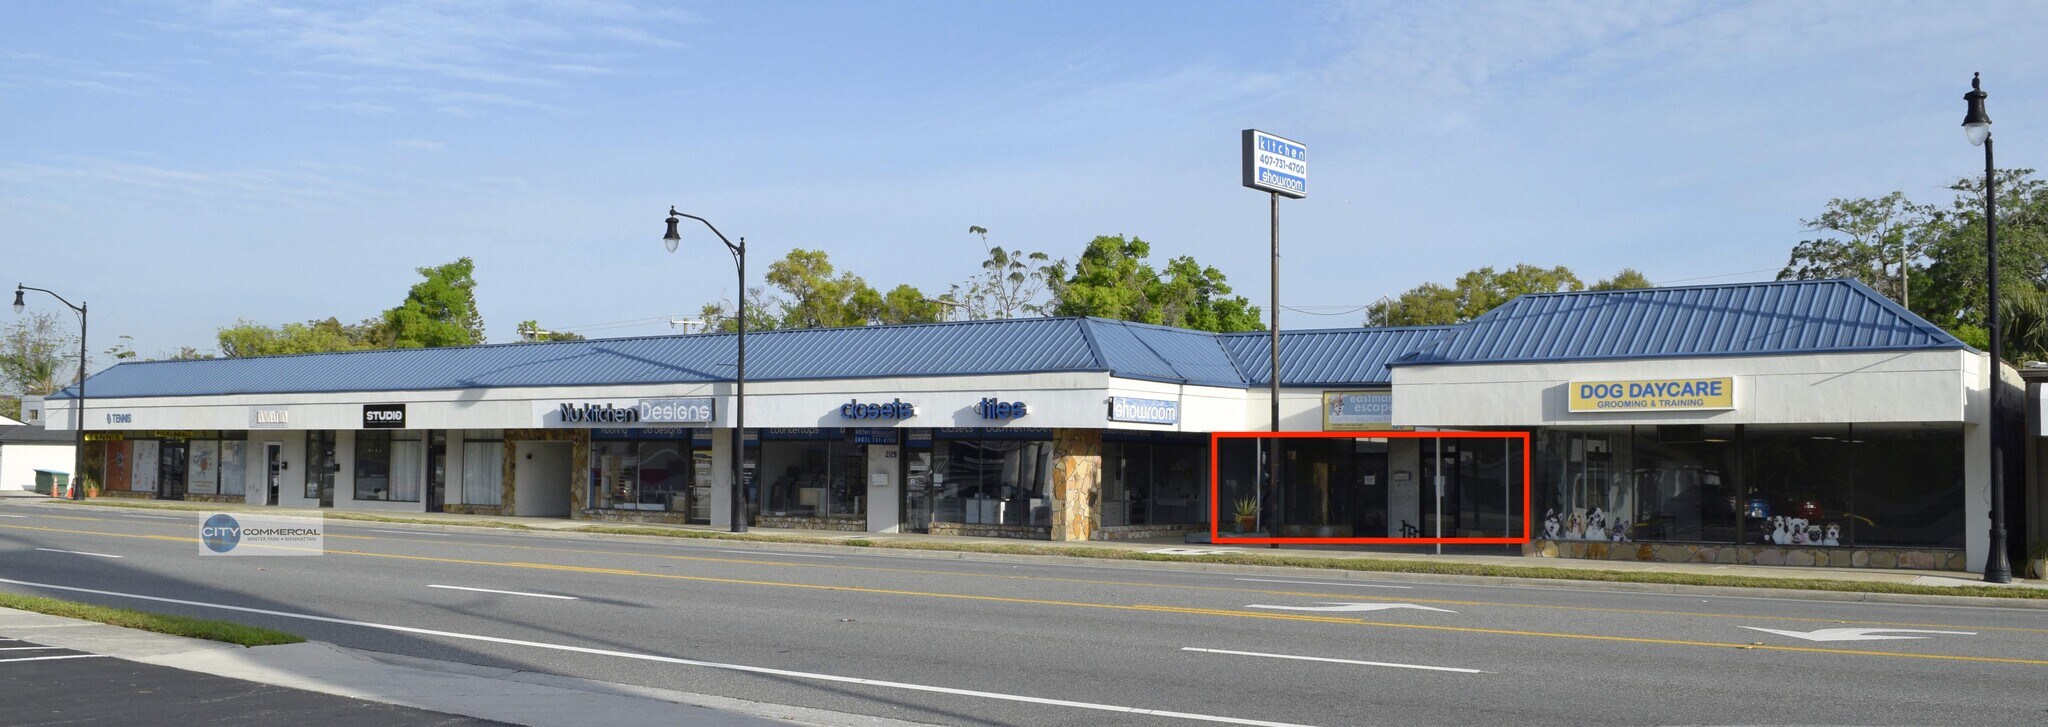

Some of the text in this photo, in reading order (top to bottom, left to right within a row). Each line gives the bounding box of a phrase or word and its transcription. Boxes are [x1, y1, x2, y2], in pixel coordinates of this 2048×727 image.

[1260, 137, 1304, 160] kitchen
[1260, 154, 1305, 175] 407-731-4700
[1262, 168, 1303, 191] showroom
[1580, 380, 1722, 399] DOG DAYCARE
[560, 401, 710, 423] Nu kitchen Designs
[841, 398, 915, 420] closets
[979, 397, 1027, 420] tiles
[1115, 399, 1175, 421] showroom
[1597, 398, 1704, 409] GROOMING & TRAINING
[112, 413, 132, 423] TENNIS
[770, 427, 819, 437] countertops
